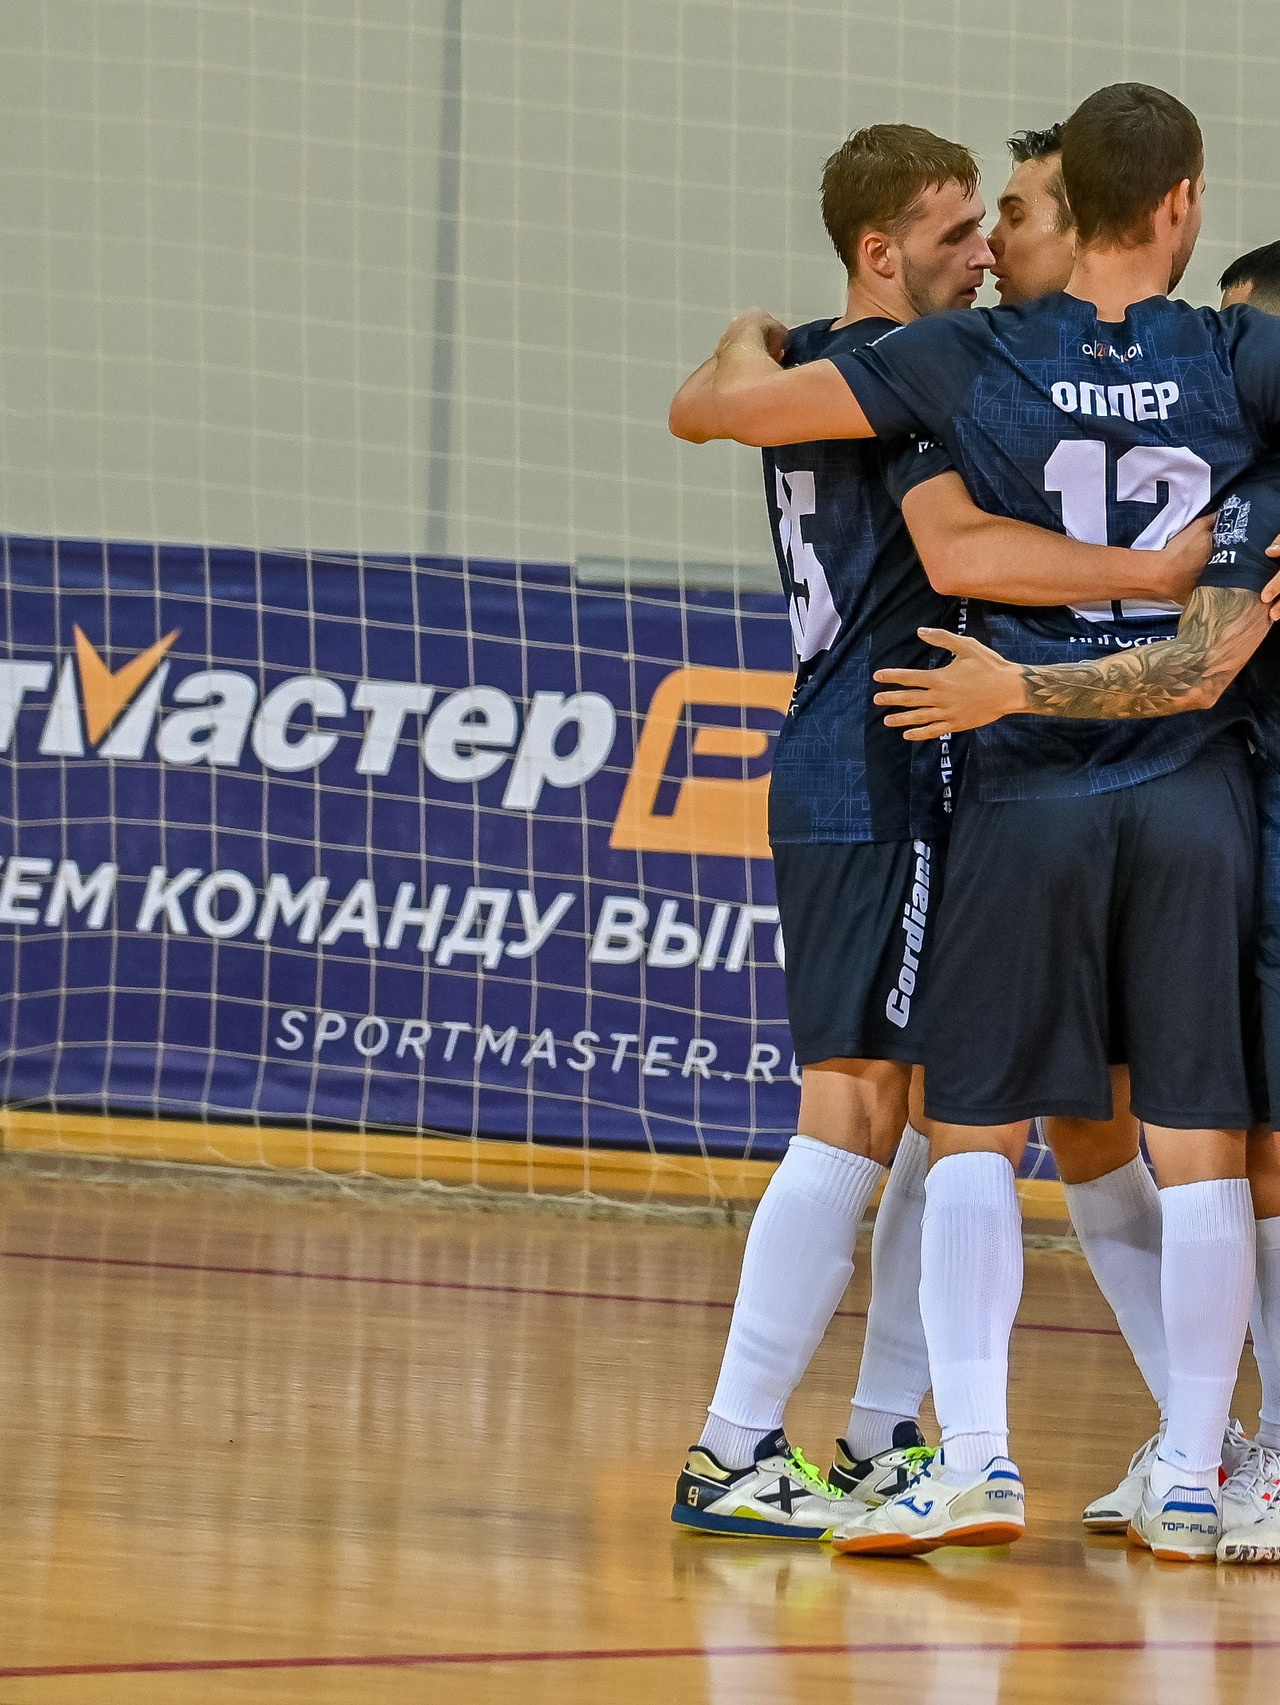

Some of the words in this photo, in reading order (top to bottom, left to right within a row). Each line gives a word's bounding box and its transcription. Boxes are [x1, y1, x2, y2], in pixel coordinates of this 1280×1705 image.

[1050, 380, 1180, 422] ОППЕР
[1044, 439, 1211, 622] 12
[0, 855, 118, 929] ЕМ
[136, 865, 576, 969] КОМАНДУ
[588, 896, 786, 973] ВЫГ
